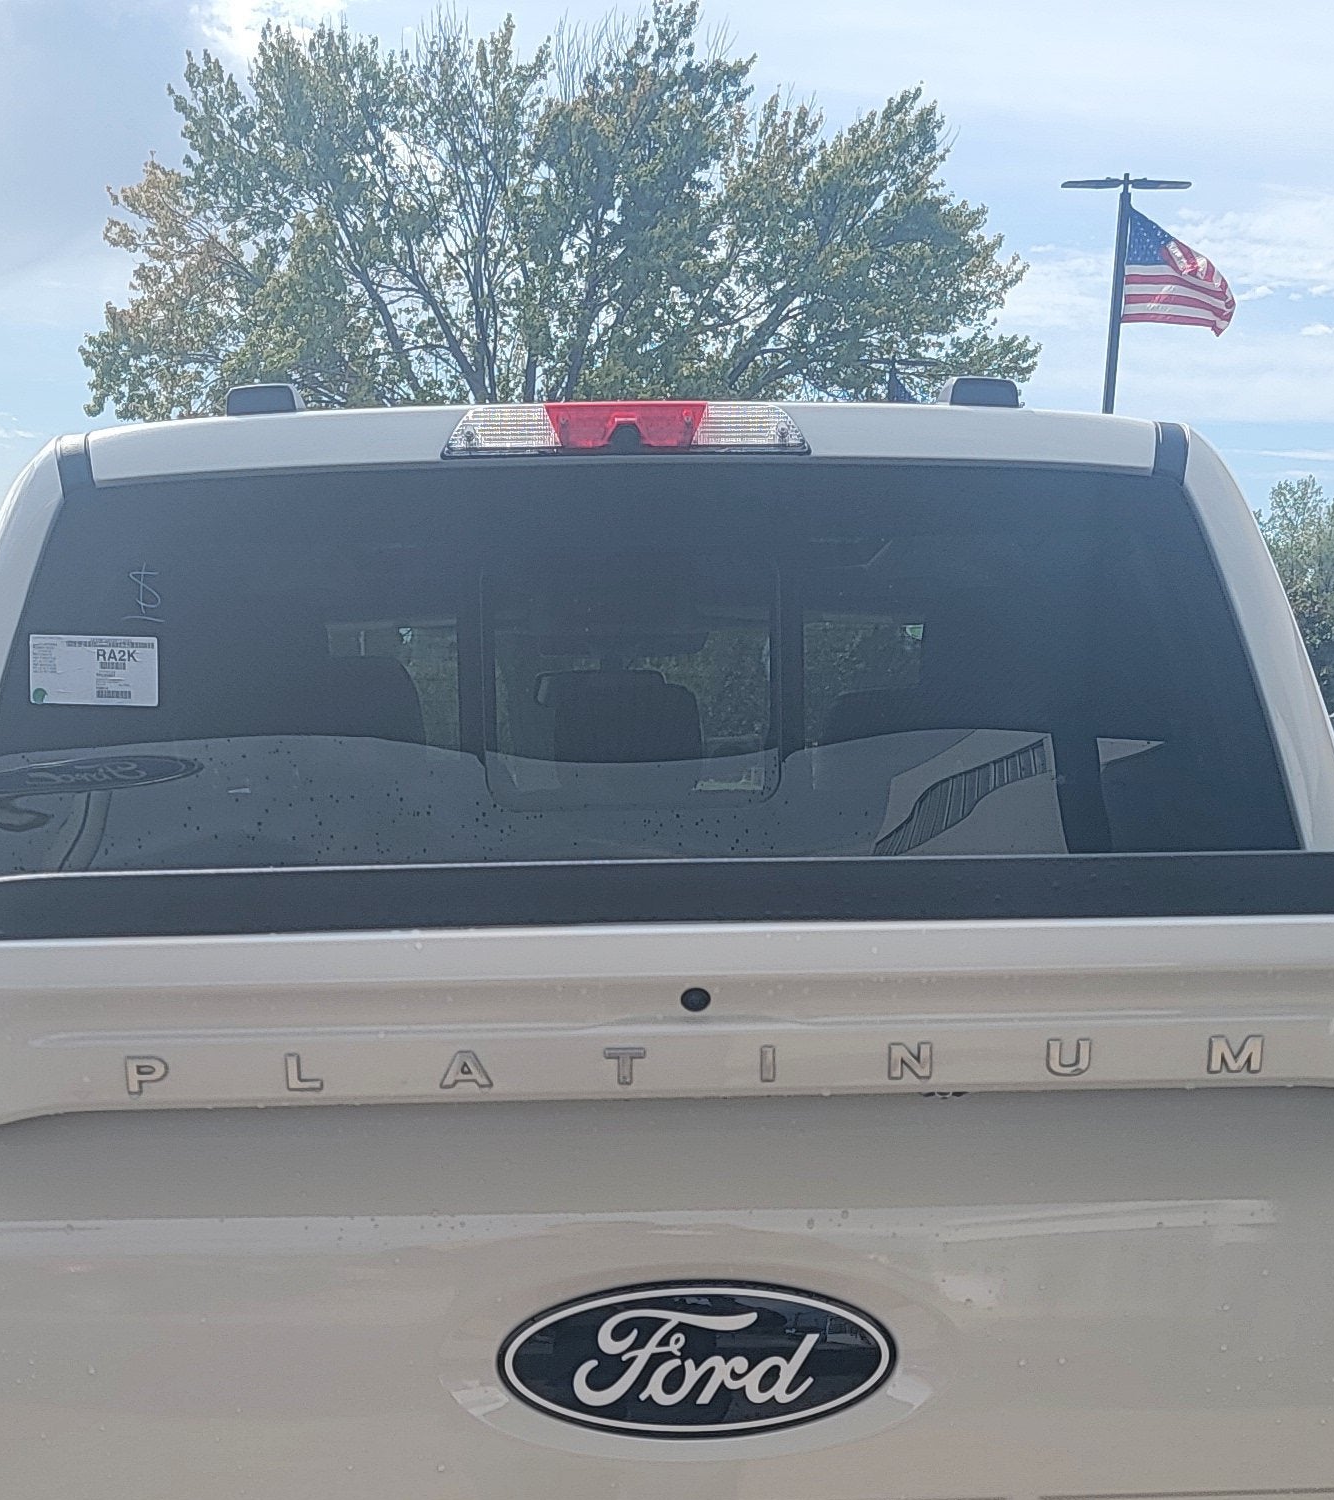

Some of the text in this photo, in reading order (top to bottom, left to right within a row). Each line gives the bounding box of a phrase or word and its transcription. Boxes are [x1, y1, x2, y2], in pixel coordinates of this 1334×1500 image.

[97, 649, 138, 662] RA2K
[125, 1034, 1265, 1097] PLATINUM
[573, 1309, 820, 1406] Ford
